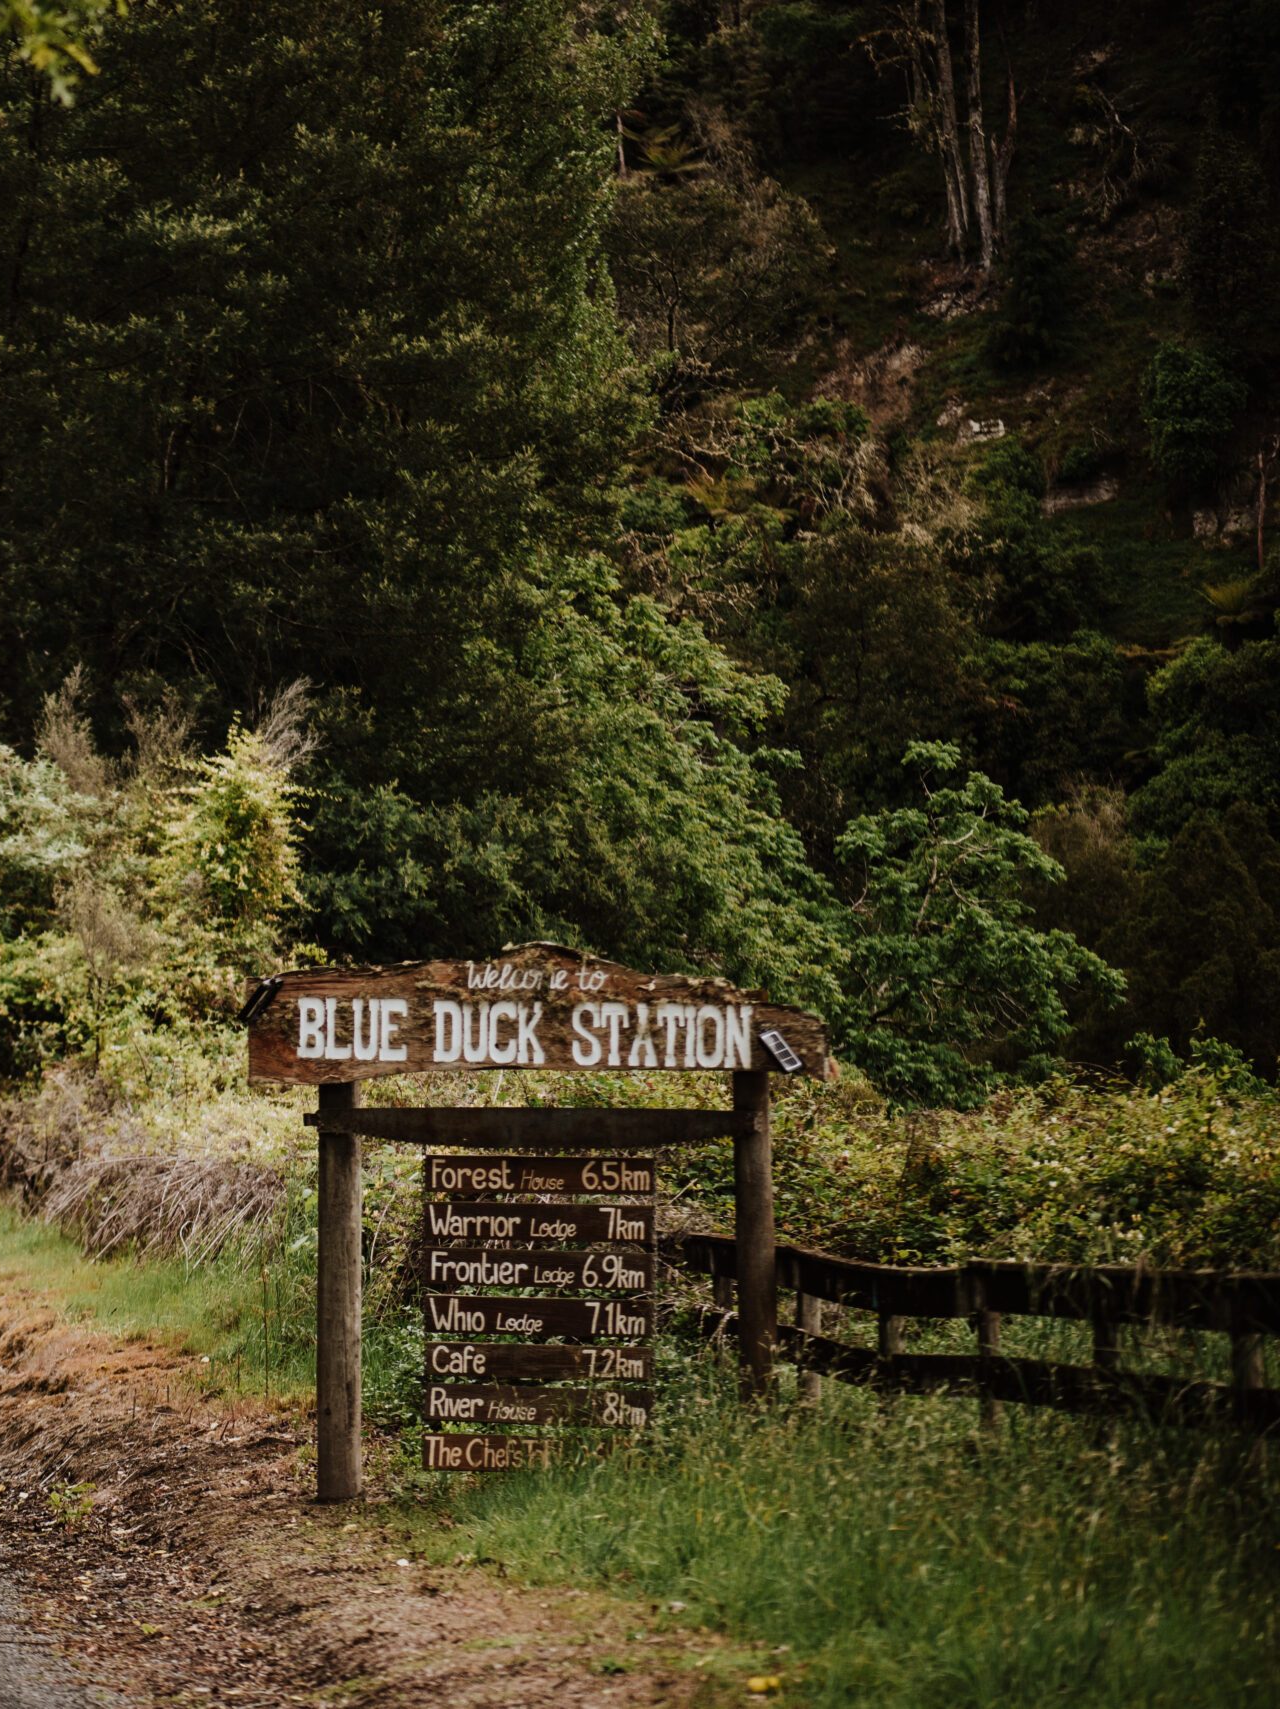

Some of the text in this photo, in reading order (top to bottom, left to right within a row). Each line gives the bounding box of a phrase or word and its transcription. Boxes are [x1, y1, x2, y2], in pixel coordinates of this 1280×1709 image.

[575, 965, 609, 991] to
[296, 997, 754, 1068] BLUE DUCK STATION
[431, 1158, 651, 1192] Forest House 6.5km
[428, 1204, 645, 1241] Warrior Lodge 7km
[430, 1251, 645, 1289] Frontier Lodge 6.9km
[429, 1297, 646, 1336] Whio Lodge 7.1km
[431, 1345, 486, 1375] Cafe
[429, 1387, 484, 1418] River
[487, 1399, 537, 1421] House
[424, 1435, 462, 1467] The
